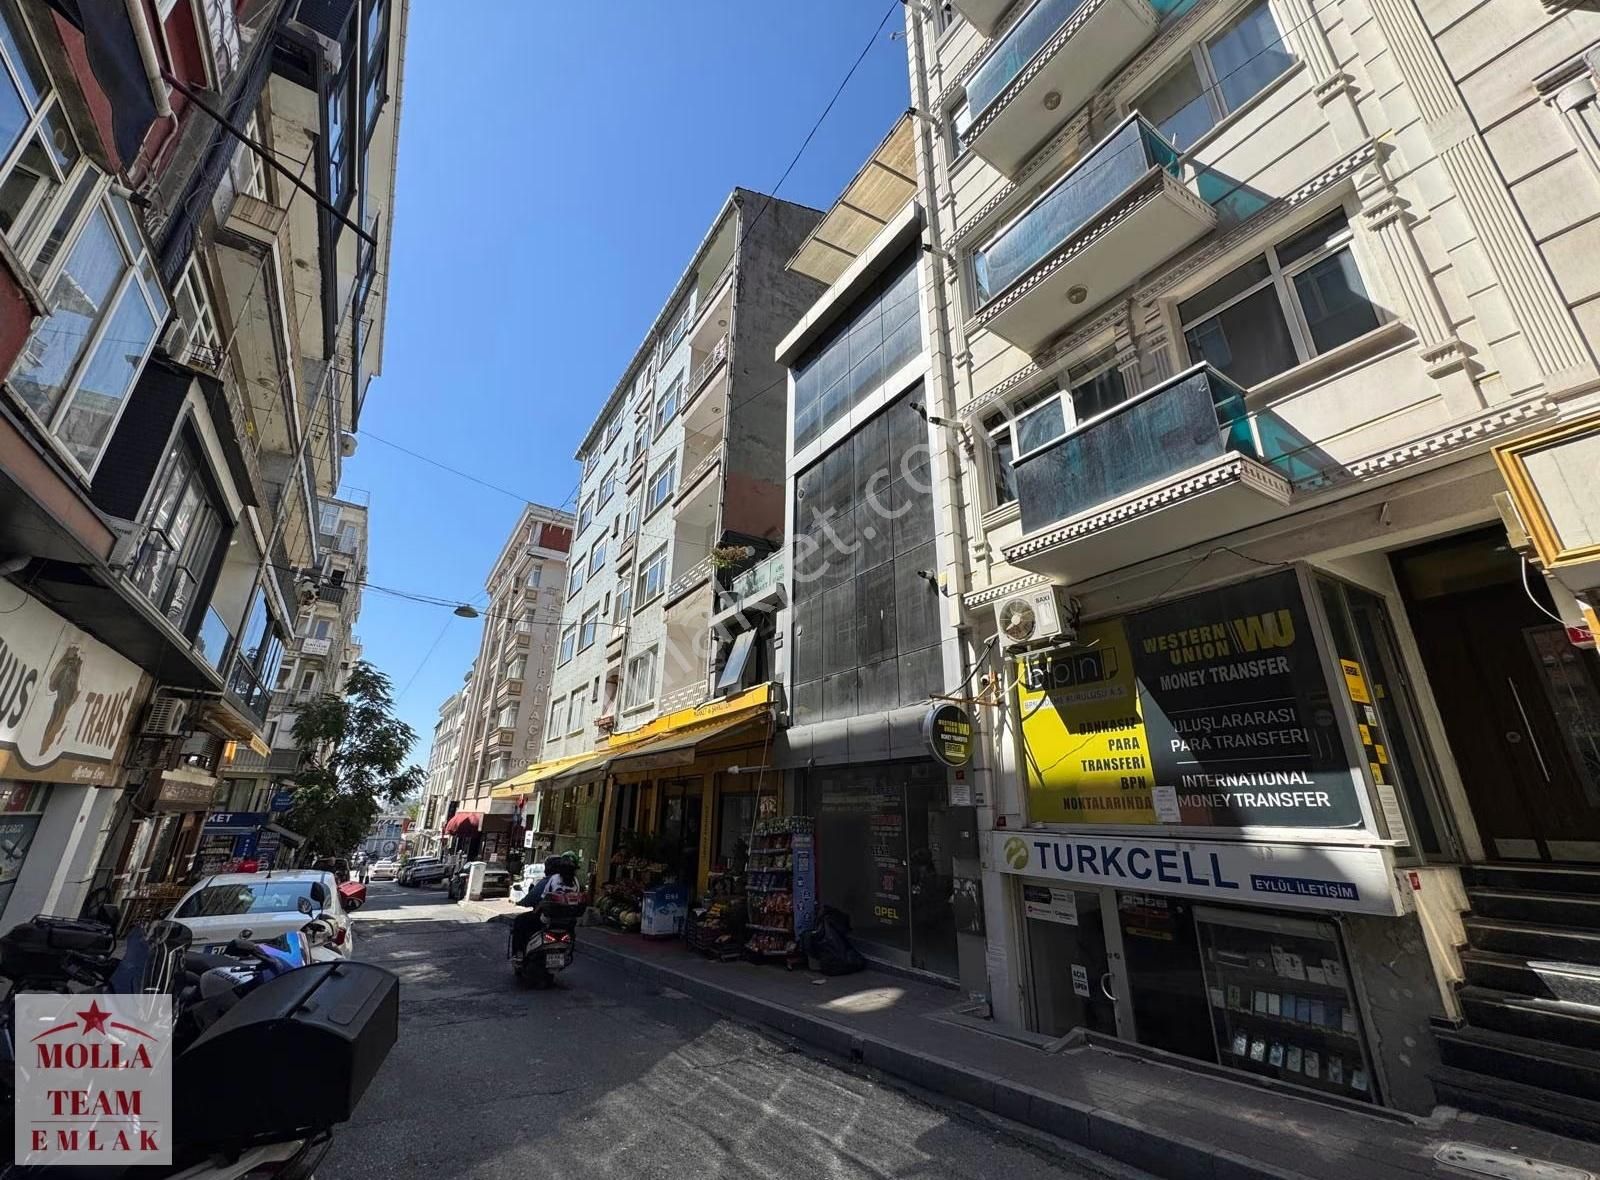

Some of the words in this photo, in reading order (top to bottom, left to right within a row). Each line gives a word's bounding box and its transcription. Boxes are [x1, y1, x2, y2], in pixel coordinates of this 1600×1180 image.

[1143, 623, 1226, 654] WESTERN
[1234, 609, 1296, 652] WU
[1169, 640, 1231, 665] UNION
[1160, 669, 1207, 691] MONEY
[1209, 656, 1290, 684] TRANSFER
[75, 687, 133, 749] TRANS
[1174, 708, 1296, 733] ULUŞLARARASI
[1108, 737, 1140, 751] PARA
[1170, 737, 1212, 752] PARA
[1081, 755, 1146, 772] TRANSFERİ
[1120, 776, 1146, 790] BPN
[1182, 771, 1315, 788] INTERNATIONAL
[1064, 796, 1153, 810] NOKTALARINDA
[1178, 794, 1231, 808] MONEY
[1233, 791, 1331, 808] TRANSFER
[1034, 842, 1240, 889] TURKCELL
[1255, 879, 1295, 892] EYLÜL
[1296, 880, 1354, 898] İLETİŞİM
